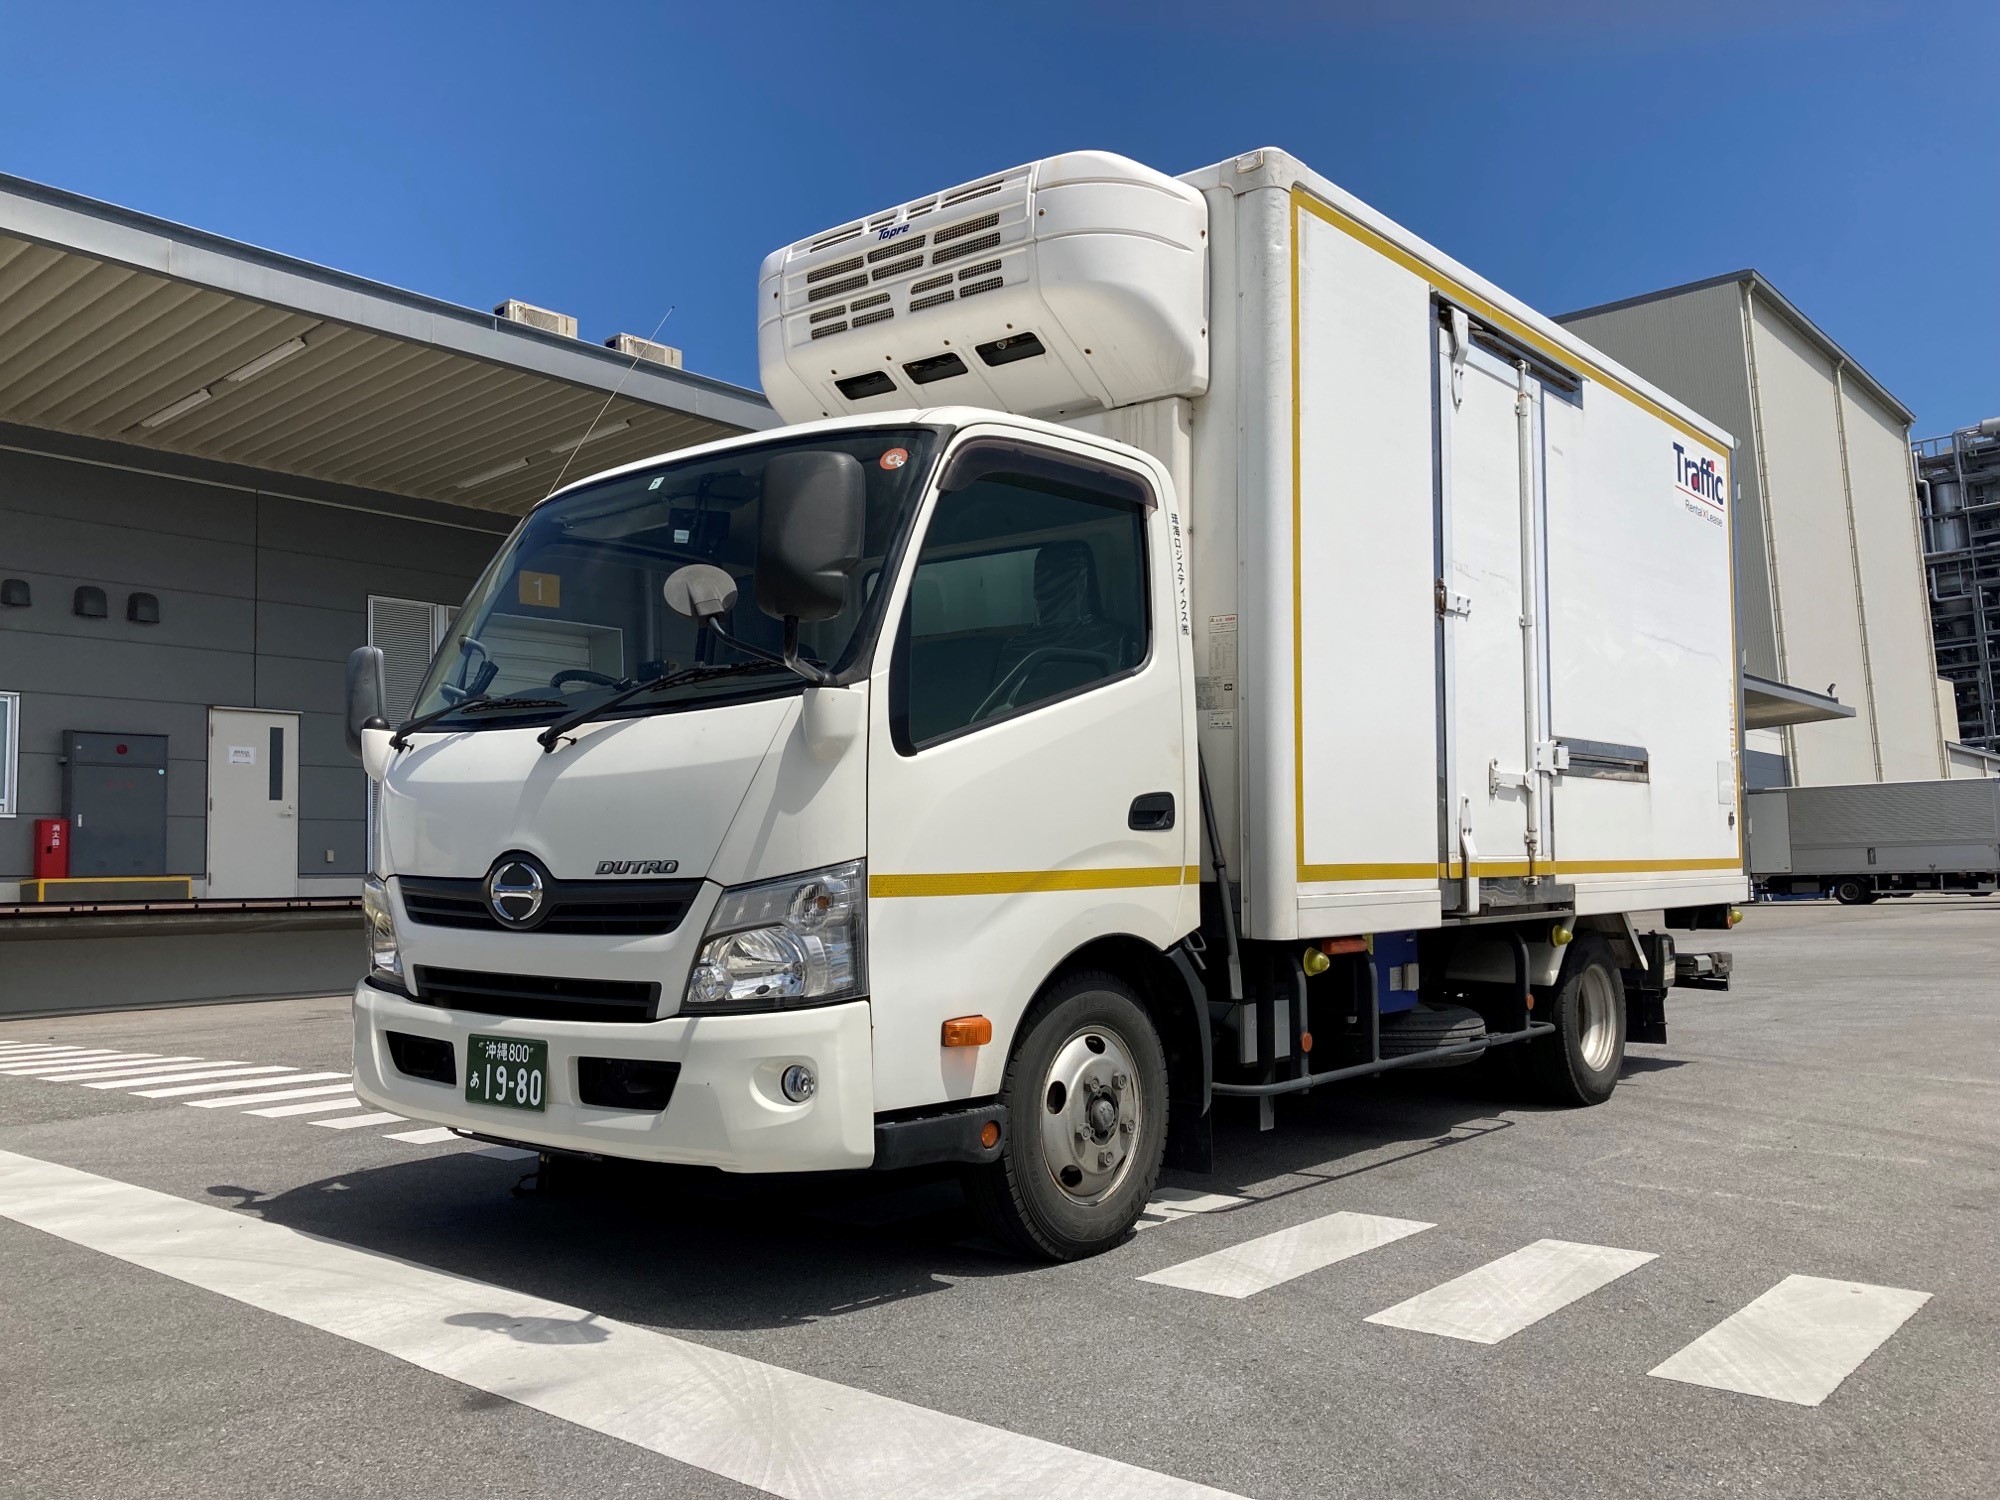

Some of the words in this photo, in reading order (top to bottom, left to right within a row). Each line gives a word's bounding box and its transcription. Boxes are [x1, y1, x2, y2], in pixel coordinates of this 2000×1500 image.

[878, 223, 910, 241] Topre
[1672, 441, 1724, 505] Traffic
[595, 859, 679, 875] DUTRO
